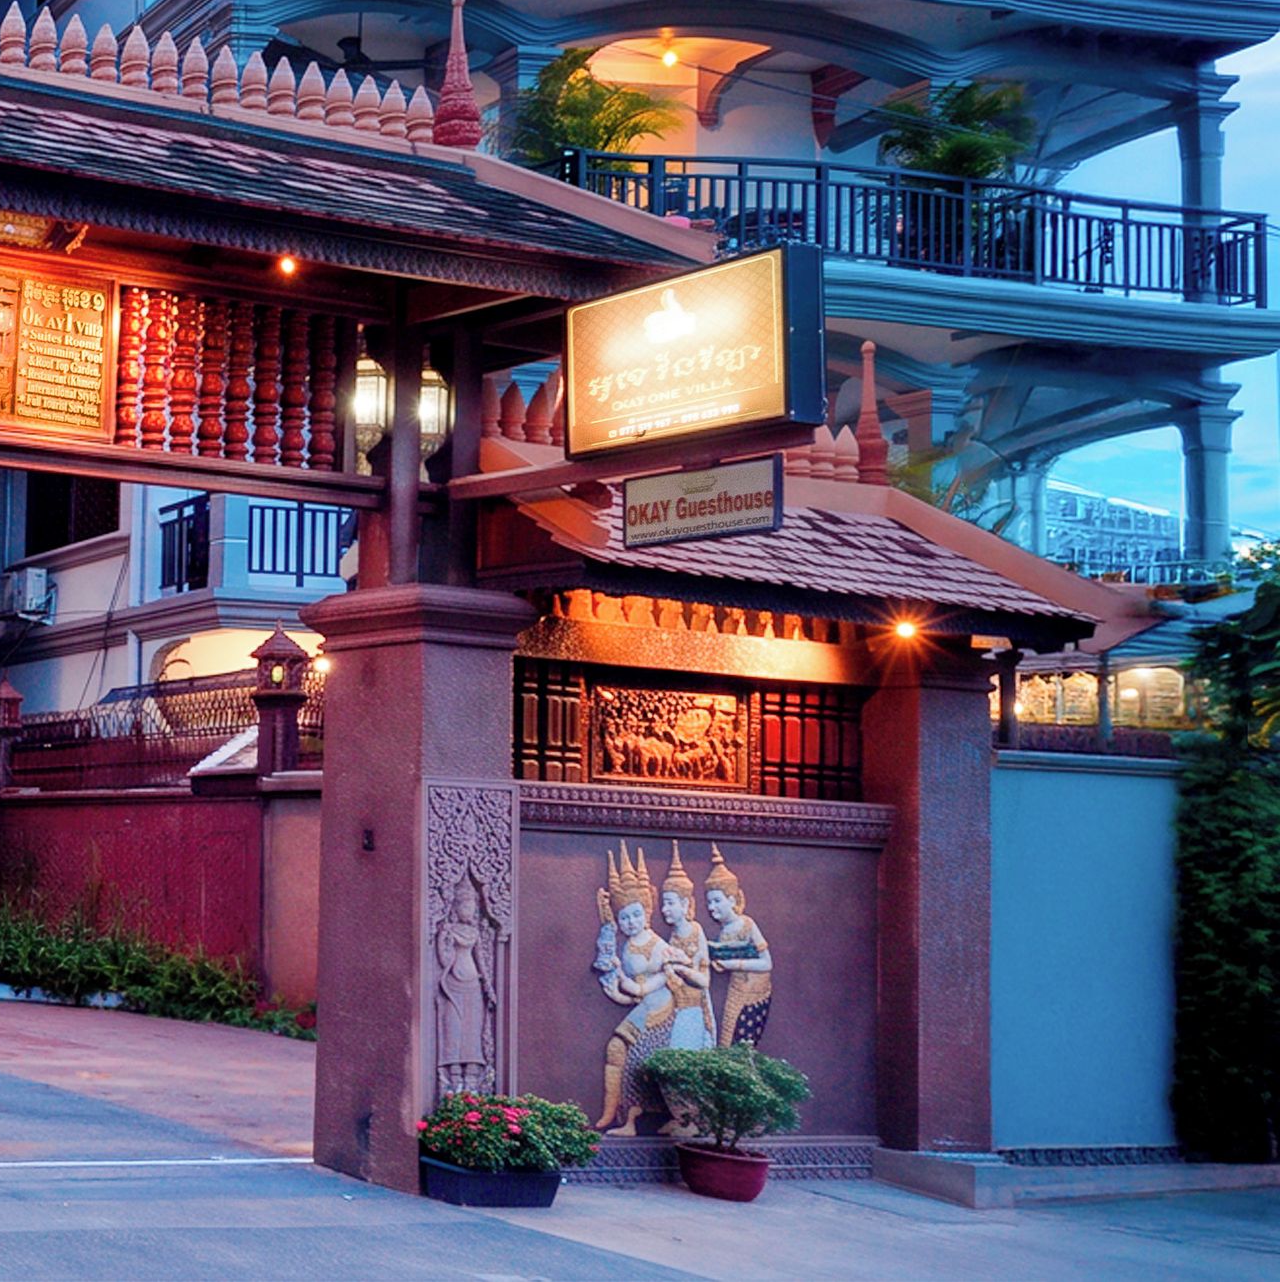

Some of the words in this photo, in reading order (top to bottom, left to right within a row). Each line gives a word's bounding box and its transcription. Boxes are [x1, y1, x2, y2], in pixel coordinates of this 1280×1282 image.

[29, 342, 80, 362] Swimming
[81, 349, 103, 364] Pool
[612, 395, 645, 411] OKAY
[647, 388, 681, 404] ONE
[685, 377, 734, 396] VILLA
[627, 499, 671, 527] OKAY
[675, 490, 773, 519] Guesthouse
